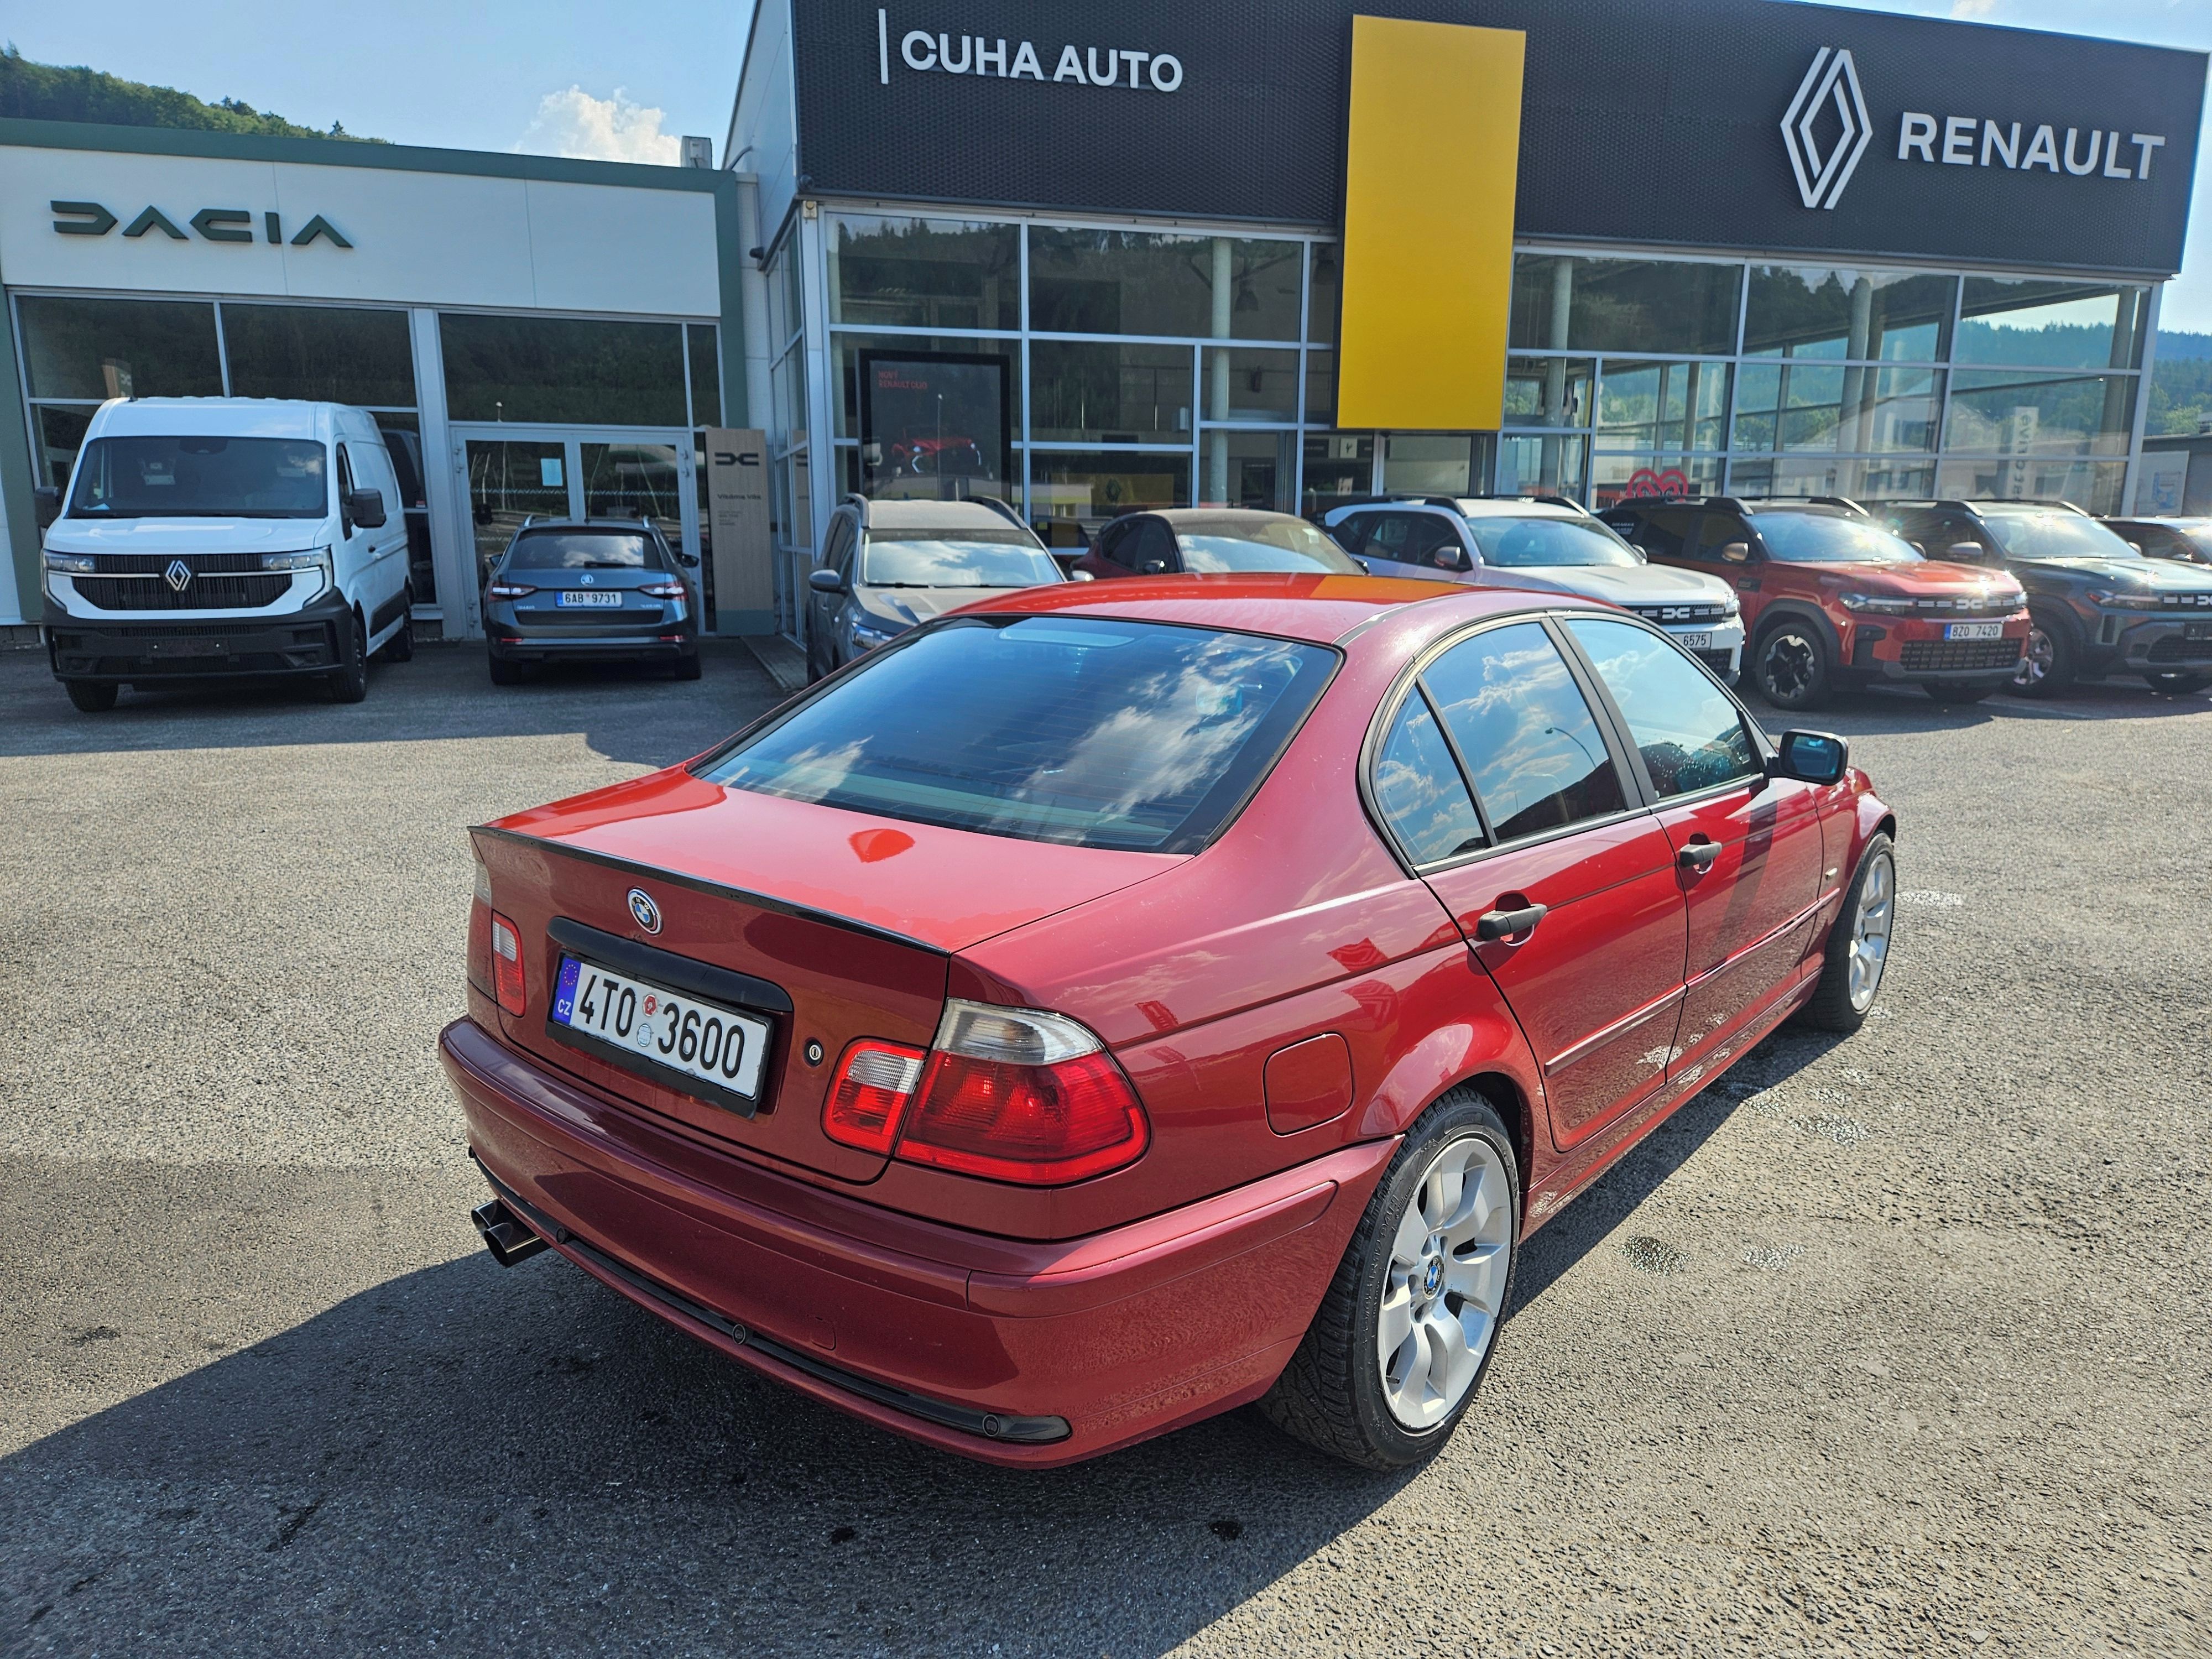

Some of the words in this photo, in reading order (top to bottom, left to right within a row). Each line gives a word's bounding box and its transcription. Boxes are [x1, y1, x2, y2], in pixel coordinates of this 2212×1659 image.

[901, 30, 1044, 81] CUHA
[1052, 45, 1183, 92] AUTO
[1898, 111, 2166, 180] RENAULT
[50, 200, 353, 248] DACIA
[565, 592, 584, 603] 6AB
[591, 592, 617, 603] 9731
[1683, 634, 1707, 646] 6575
[1976, 625, 1999, 637] 7420
[631, 897, 650, 910] BMW
[557, 998, 572, 1016] CZ
[657, 1002, 745, 1079] 3600
